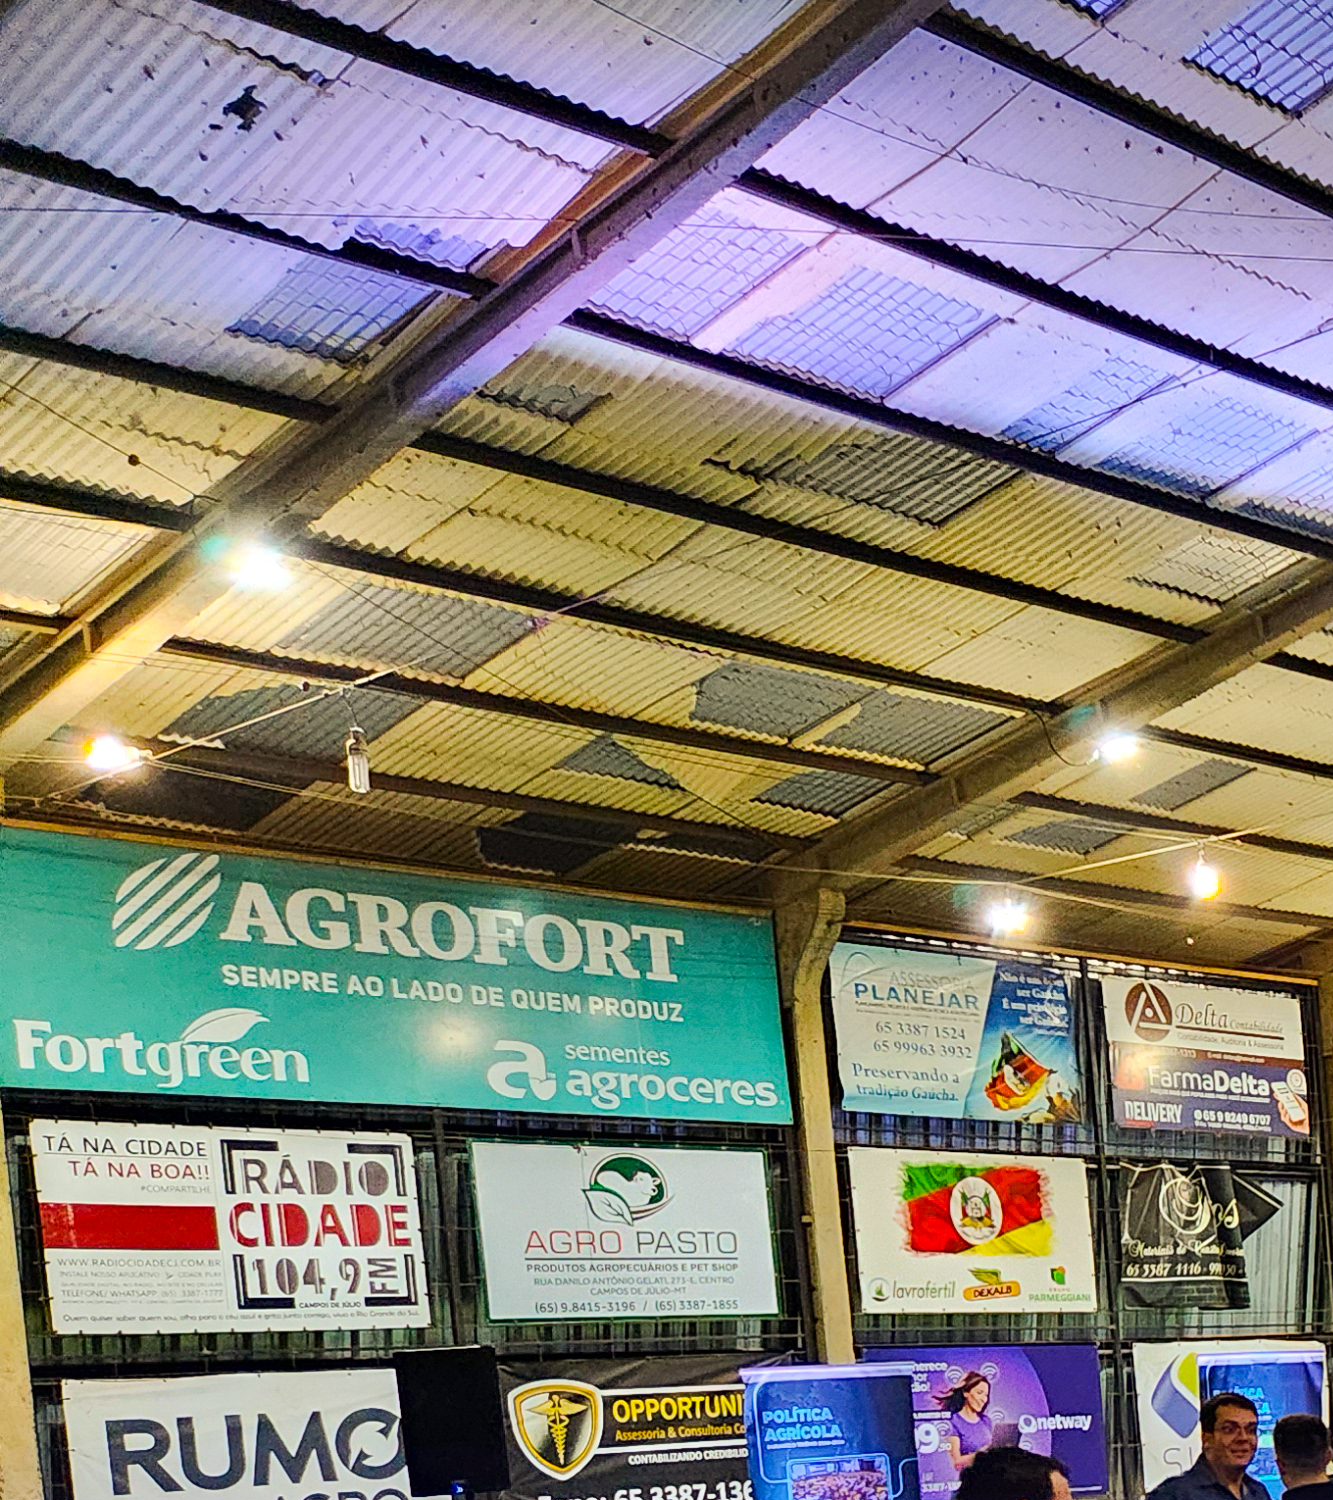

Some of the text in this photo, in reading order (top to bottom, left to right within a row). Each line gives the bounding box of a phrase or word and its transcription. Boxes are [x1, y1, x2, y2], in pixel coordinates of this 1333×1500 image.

[219, 882, 684, 982] AGROFORT
[221, 964, 684, 1022] SEMPRE AO LADO DE QUEM PRODUZ
[854, 982, 979, 1009] PLANEJAR
[1175, 1002, 1229, 1028] Delta
[876, 1021, 965, 1039] 65 3387 1524
[12, 1016, 310, 1088] Fortgreen
[564, 1042, 671, 1068] sementes
[874, 1040, 972, 1058] 65 99963 3932
[852, 1062, 959, 1083] Preservando a
[1149, 1065, 1270, 1095] FarmaDelta
[564, 1065, 777, 1110] agroceres
[857, 1084, 908, 1099] tradição
[1124, 1101, 1182, 1123] DELIVERY
[43, 1132, 208, 1157] TÁ NA CIDADE
[68, 1157, 210, 1180] TÁ NA BOA!!
[240, 1154, 389, 1196] RÁDIO
[141, 1185, 212, 1194] #COMPARTILHE
[229, 1202, 413, 1248] CIDADE
[525, 1230, 738, 1254] AGRO PASTO
[367, 1257, 400, 1294] FM
[526, 1261, 739, 1272] PRODUTOS AGROPECUÁRIOS E PET SHOP
[252, 1258, 361, 1301] 104,9
[534, 1277, 590, 1286] RUA DANILO
[892, 1281, 956, 1299] lavrofértil
[590, 1287, 644, 1295] CAMPOS DE
[973, 1286, 1012, 1298] DEKALB
[1028, 1294, 1091, 1302] PARMEGGIANI
[535, 1300, 738, 1314] (65) 9.8415-3196 (65) 3387-1855
[612, 1393, 746, 1423] OPPORTUNI
[762, 1407, 833, 1424] POLÍTICA
[615, 1424, 732, 1442] Assessoria Consultoria
[764, 1423, 843, 1442] AGRÍCOLA
[1037, 1414, 1092, 1431] netway
[104, 1405, 408, 1496] RUMO
[628, 1452, 702, 1465] CONTABILIZANDO
